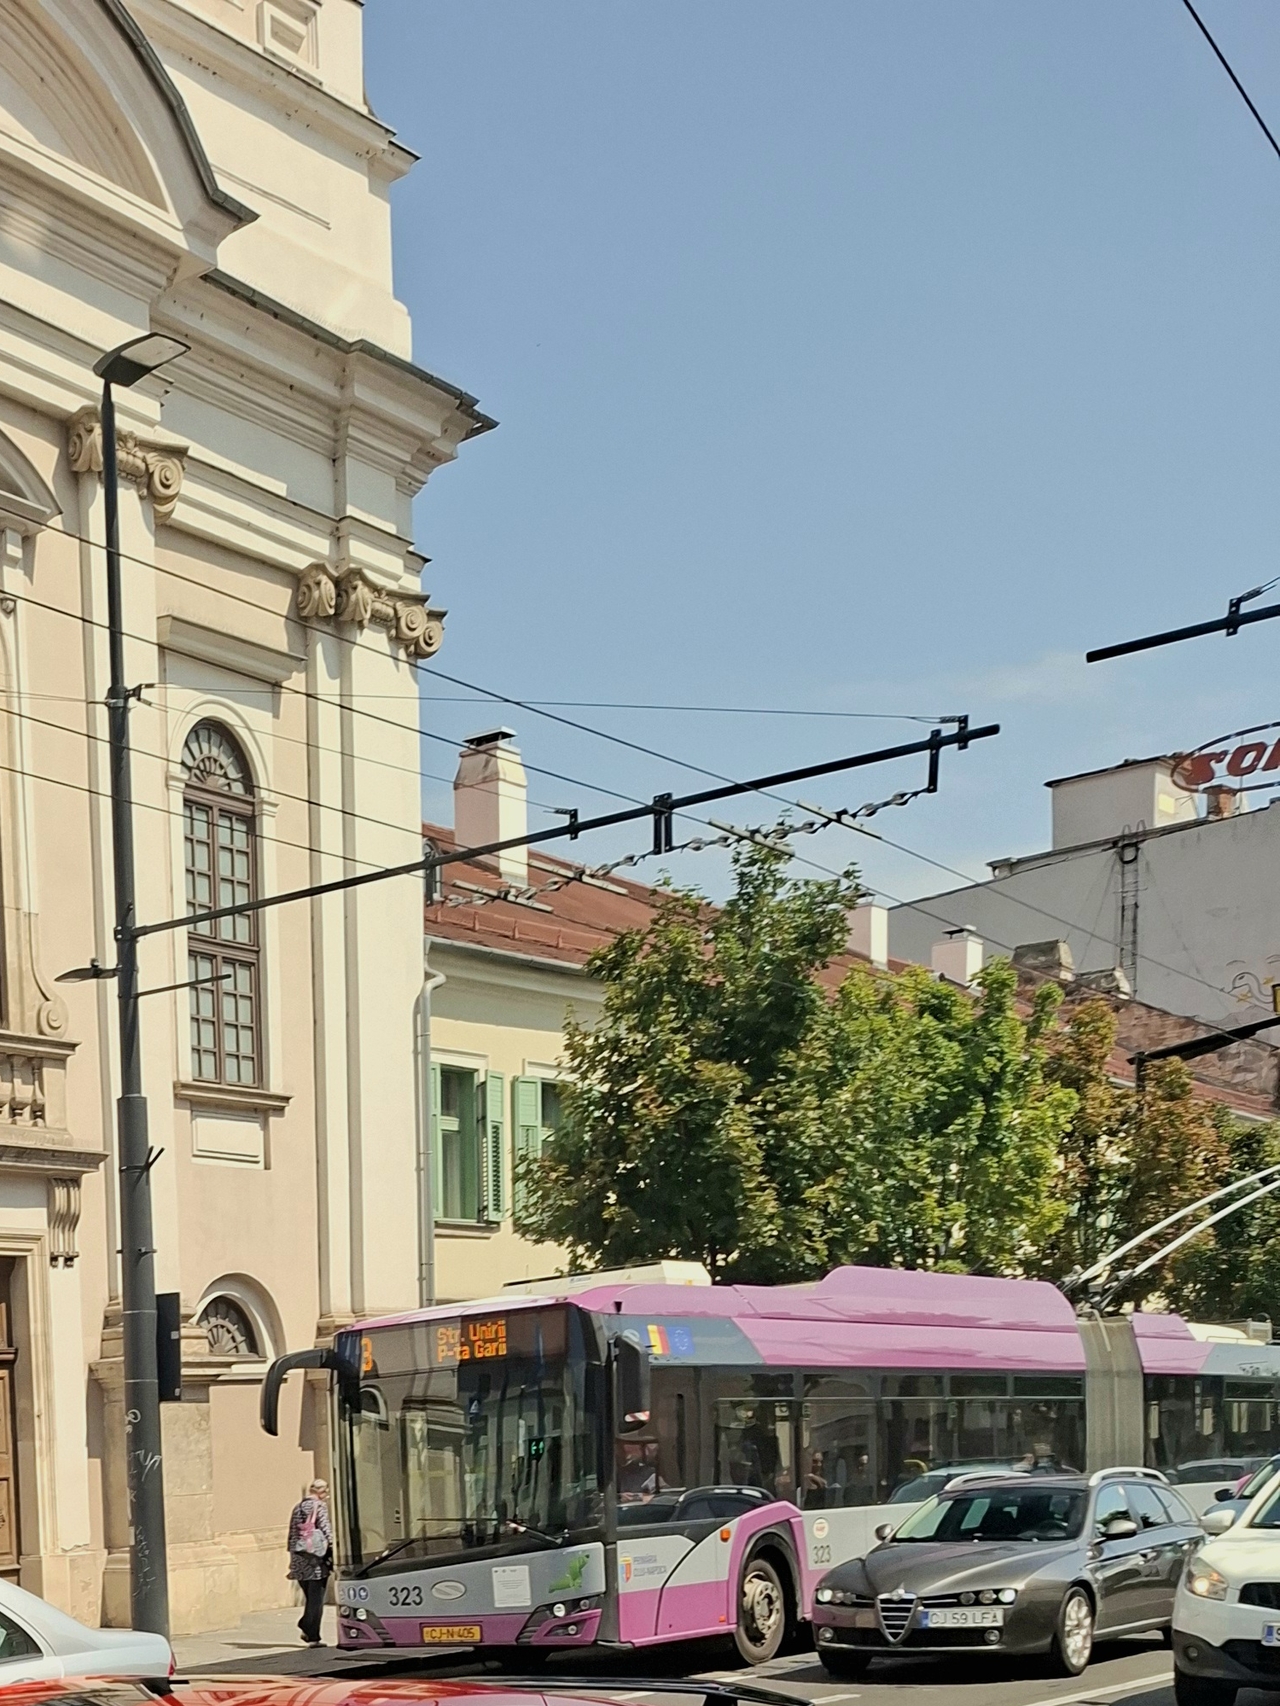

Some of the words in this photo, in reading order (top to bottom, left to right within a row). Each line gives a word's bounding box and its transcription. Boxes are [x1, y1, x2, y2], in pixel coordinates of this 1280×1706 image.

[436, 1327, 466, 1346] Str.
[468, 1320, 507, 1342] Unirii
[436, 1344, 470, 1364] P-ta
[473, 1338, 508, 1359] Garii
[812, 1544, 831, 1564] 323
[387, 1586, 423, 1607] 323
[930, 1612, 947, 1625] CJ
[951, 1612, 968, 1624] 59
[972, 1611, 999, 1624] LFA
